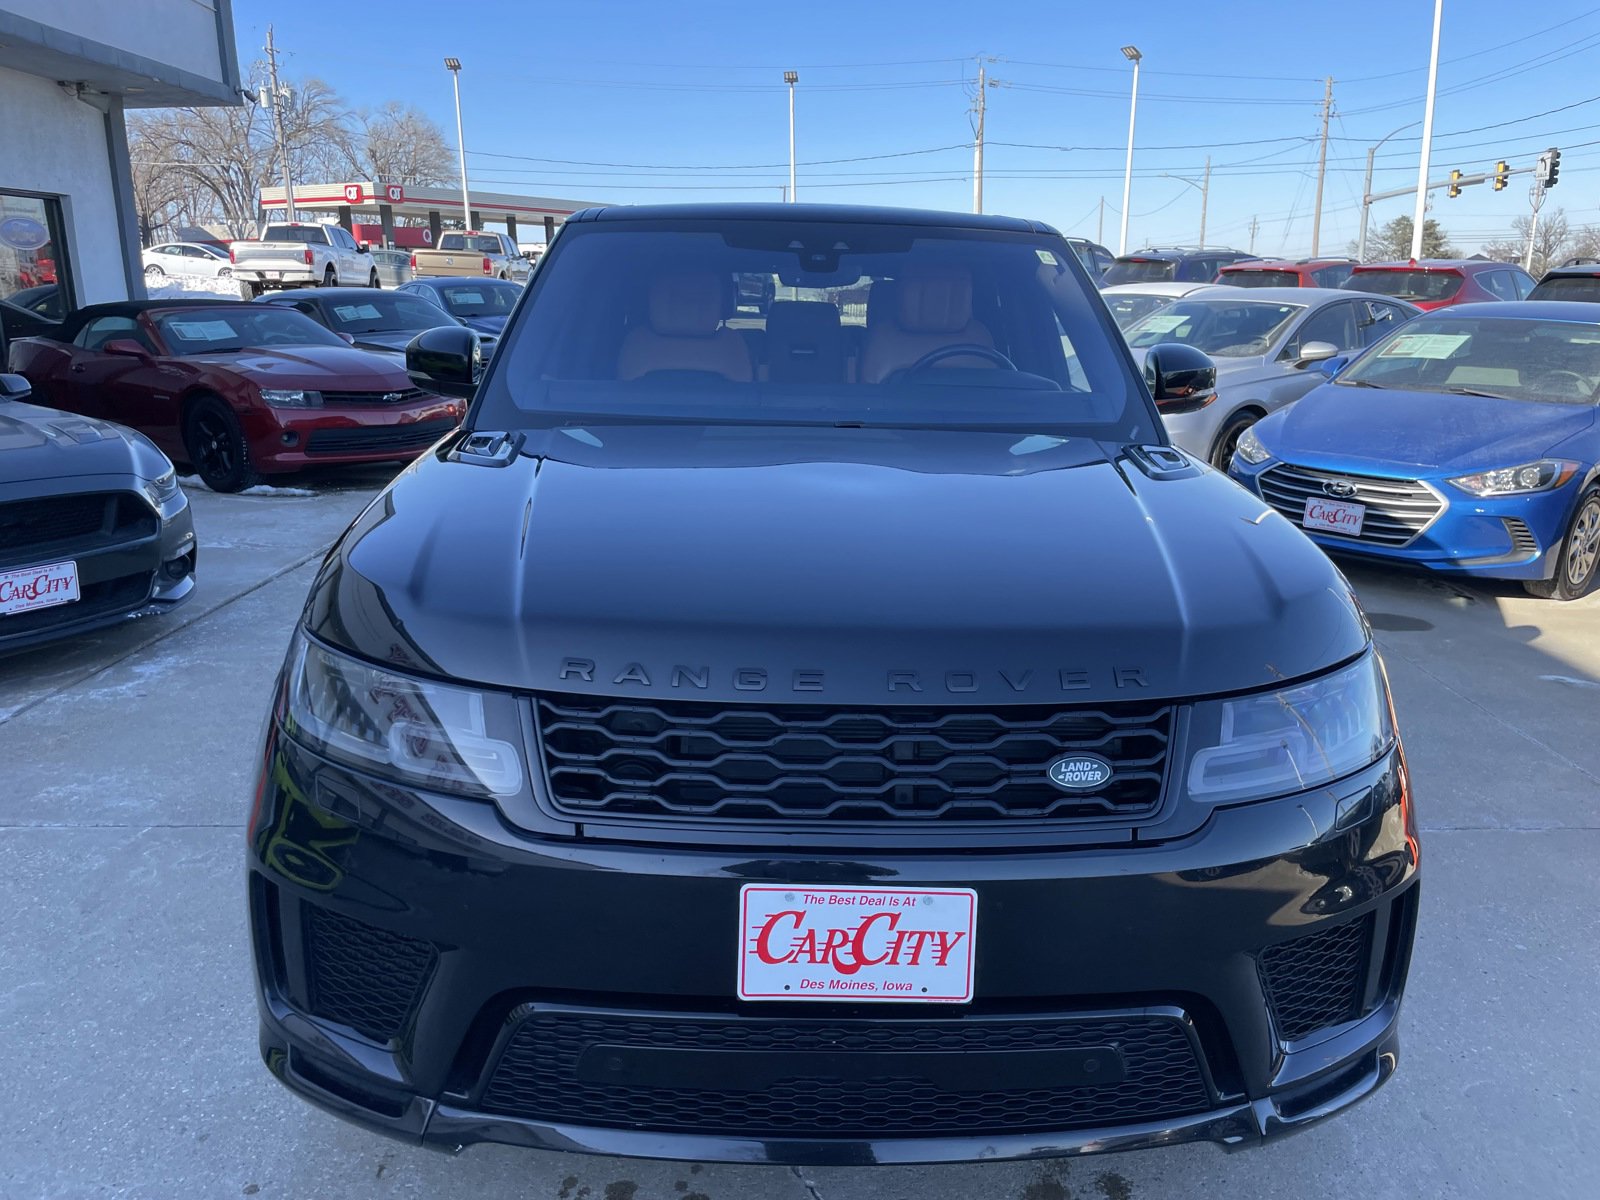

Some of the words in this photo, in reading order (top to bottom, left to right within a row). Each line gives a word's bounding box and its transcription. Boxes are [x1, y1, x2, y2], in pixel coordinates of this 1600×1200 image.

[346, 186, 358, 200] QT
[389, 187, 401, 200] QT
[559, 656, 825, 692] RANGE
[887, 665, 1150, 693] ROVER
[802, 893, 825, 906] The
[828, 894, 856, 906] Best
[859, 895, 886, 907] Deal
[889, 896, 900, 907] Is
[902, 896, 916, 907] At
[799, 978, 826, 990] Des
[828, 979, 879, 992] Moines,
[882, 980, 913, 991] Iowa
